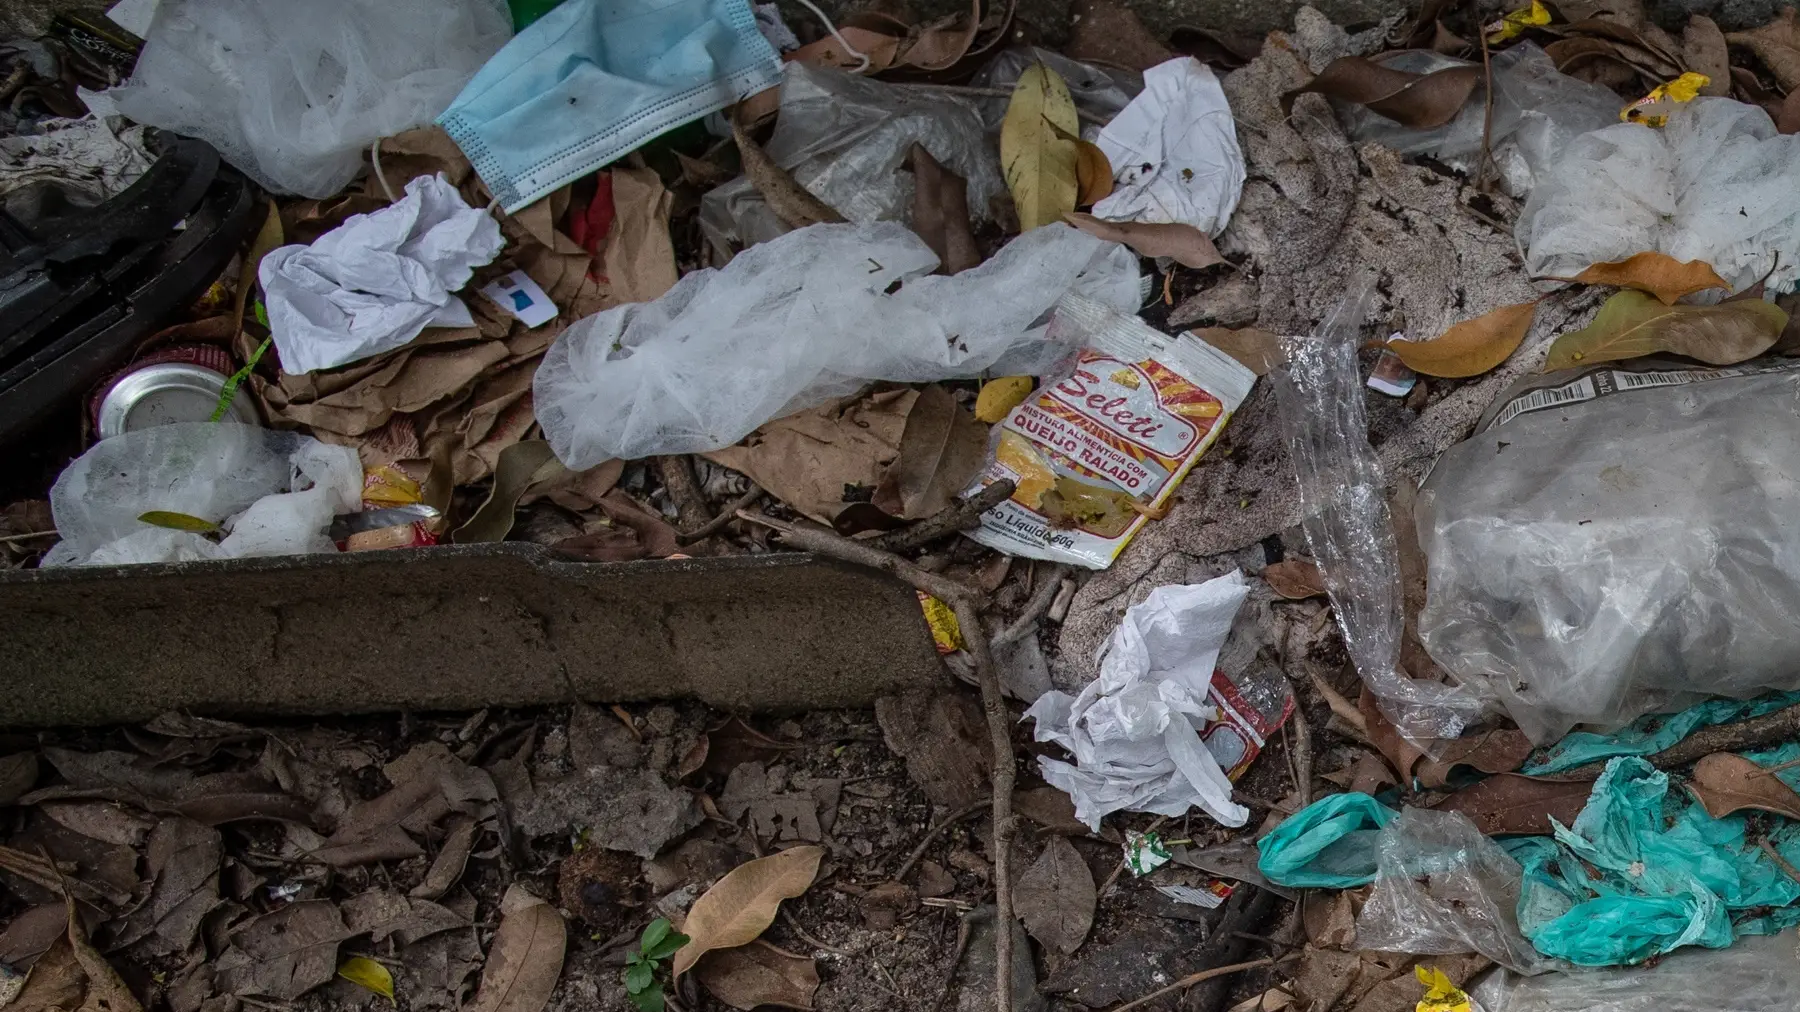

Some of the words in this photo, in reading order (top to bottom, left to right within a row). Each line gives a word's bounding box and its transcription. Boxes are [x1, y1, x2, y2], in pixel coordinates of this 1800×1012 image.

[1057, 368, 1161, 441] Seleti
[1600, 385, 1613, 394] 22
[1012, 412, 1078, 455] QUEIJO
[1077, 448, 1142, 491] RALADO
[1020, 403, 1068, 433] MISTURA
[1065, 426, 1128, 467] ALIMENTÍCIA
[1125, 460, 1149, 480] COM
